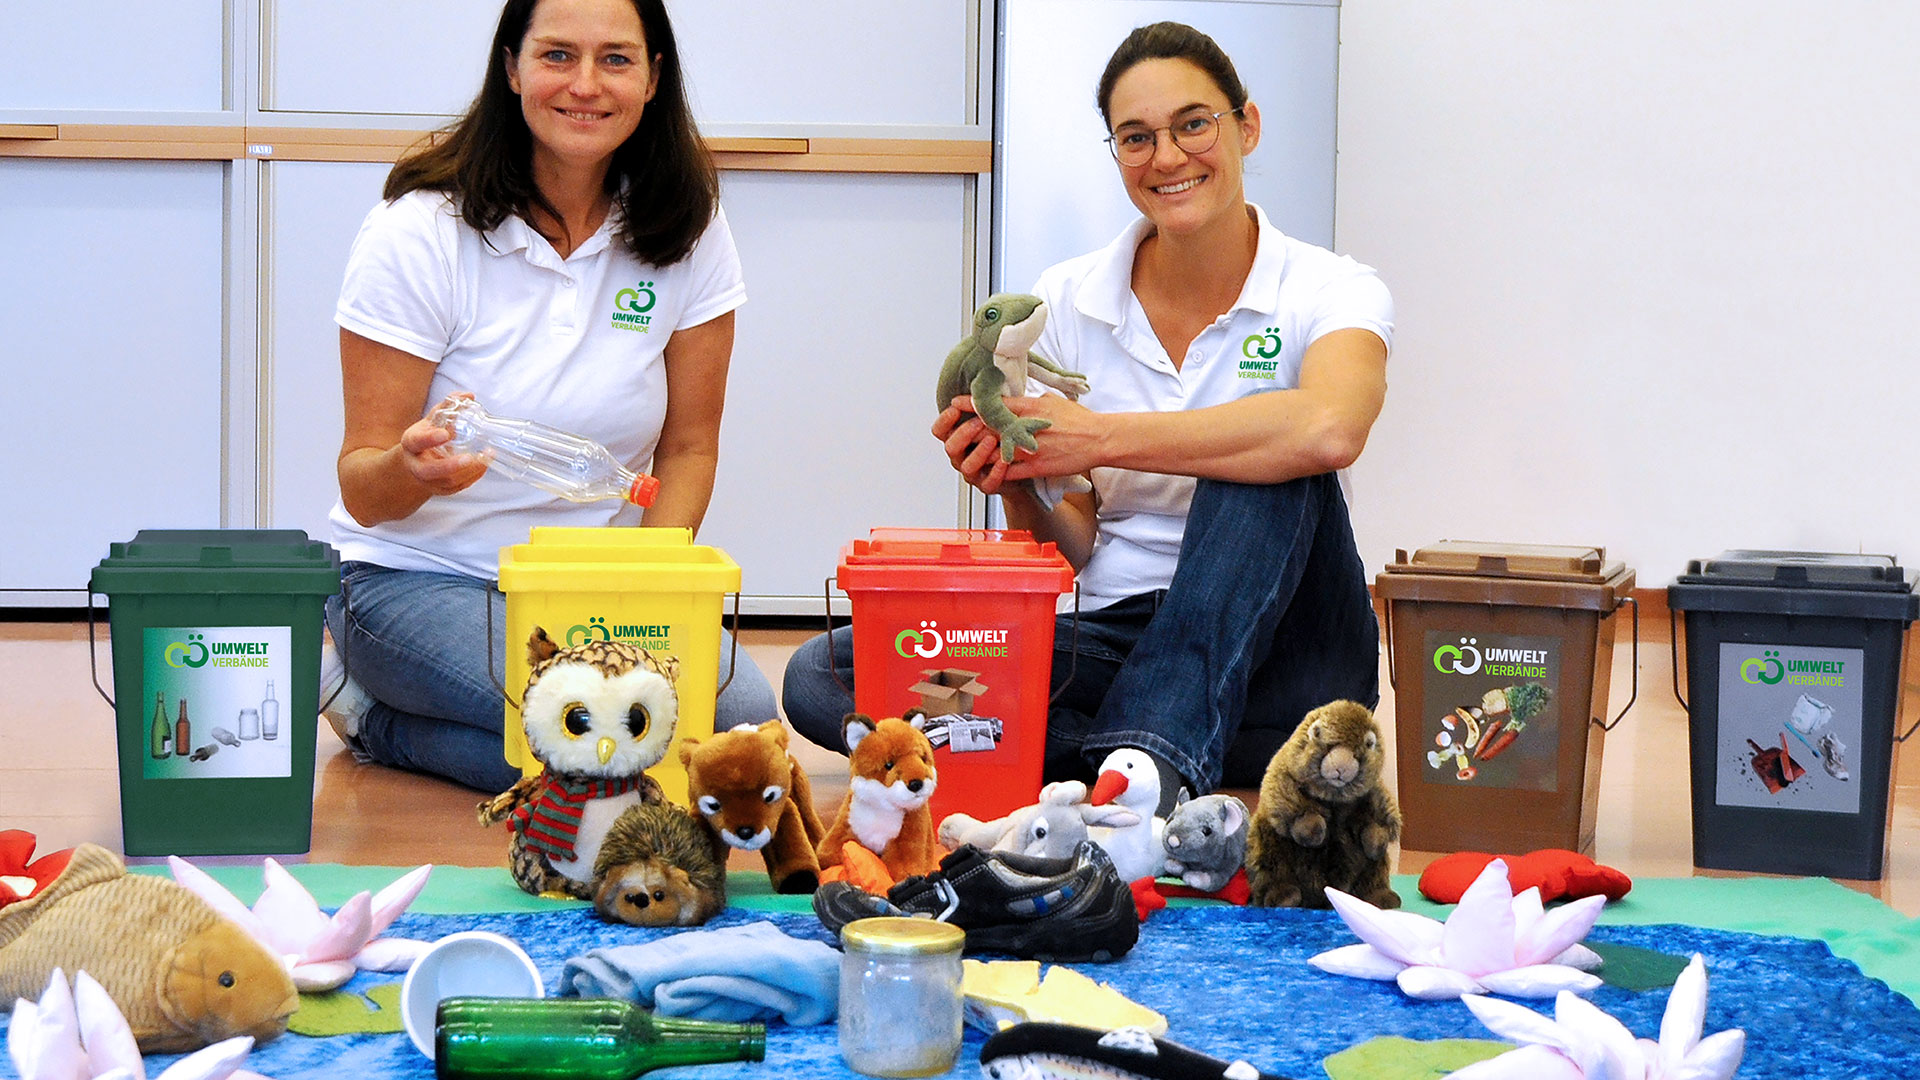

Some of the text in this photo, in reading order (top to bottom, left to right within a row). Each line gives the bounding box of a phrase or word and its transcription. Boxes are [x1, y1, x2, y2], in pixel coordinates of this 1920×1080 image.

[612, 312, 652, 325] UMWELT
[611, 321, 649, 334] VERBÄNDE
[1239, 361, 1279, 371] UMWELT
[1238, 370, 1276, 380] VERBÄNDE
[613, 625, 670, 637] UMWELT
[946, 630, 1008, 643] UMWELT
[212, 643, 269, 655] UMWELT
[620, 638, 670, 650] BÄNDE
[946, 644, 1008, 657] VERBÄNDE
[212, 655, 269, 668] VERBÄNDE
[1485, 648, 1548, 664] UMWELT
[1484, 663, 1547, 678] VERBÄNDE
[1787, 660, 1845, 674] UMWELT
[1787, 673, 1845, 687] VERBÄNDE
